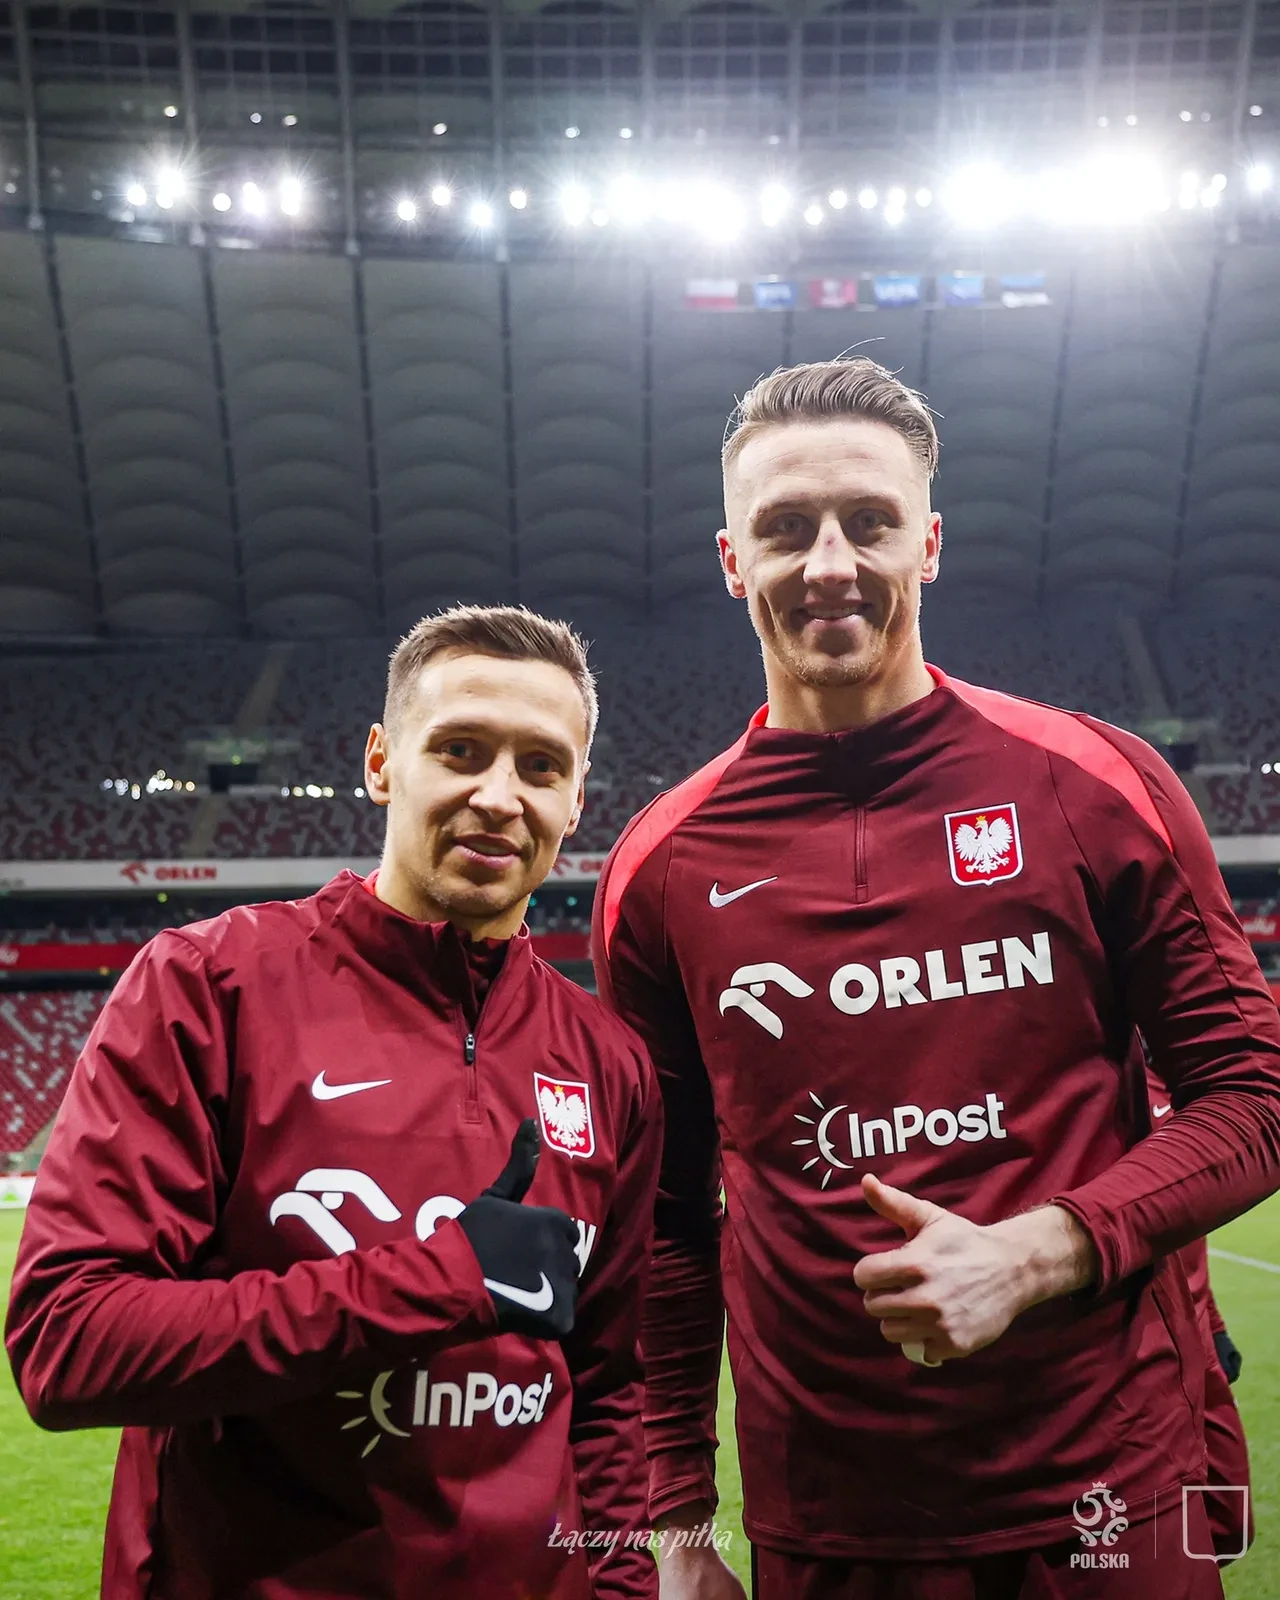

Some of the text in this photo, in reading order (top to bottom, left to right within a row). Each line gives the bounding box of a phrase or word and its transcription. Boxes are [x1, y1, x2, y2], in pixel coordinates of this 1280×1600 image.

[155, 866, 217, 881] ORLEN
[829, 931, 1054, 1015] ORLEN
[848, 1093, 1007, 1158] InPost
[412, 1370, 553, 1427] InPost
